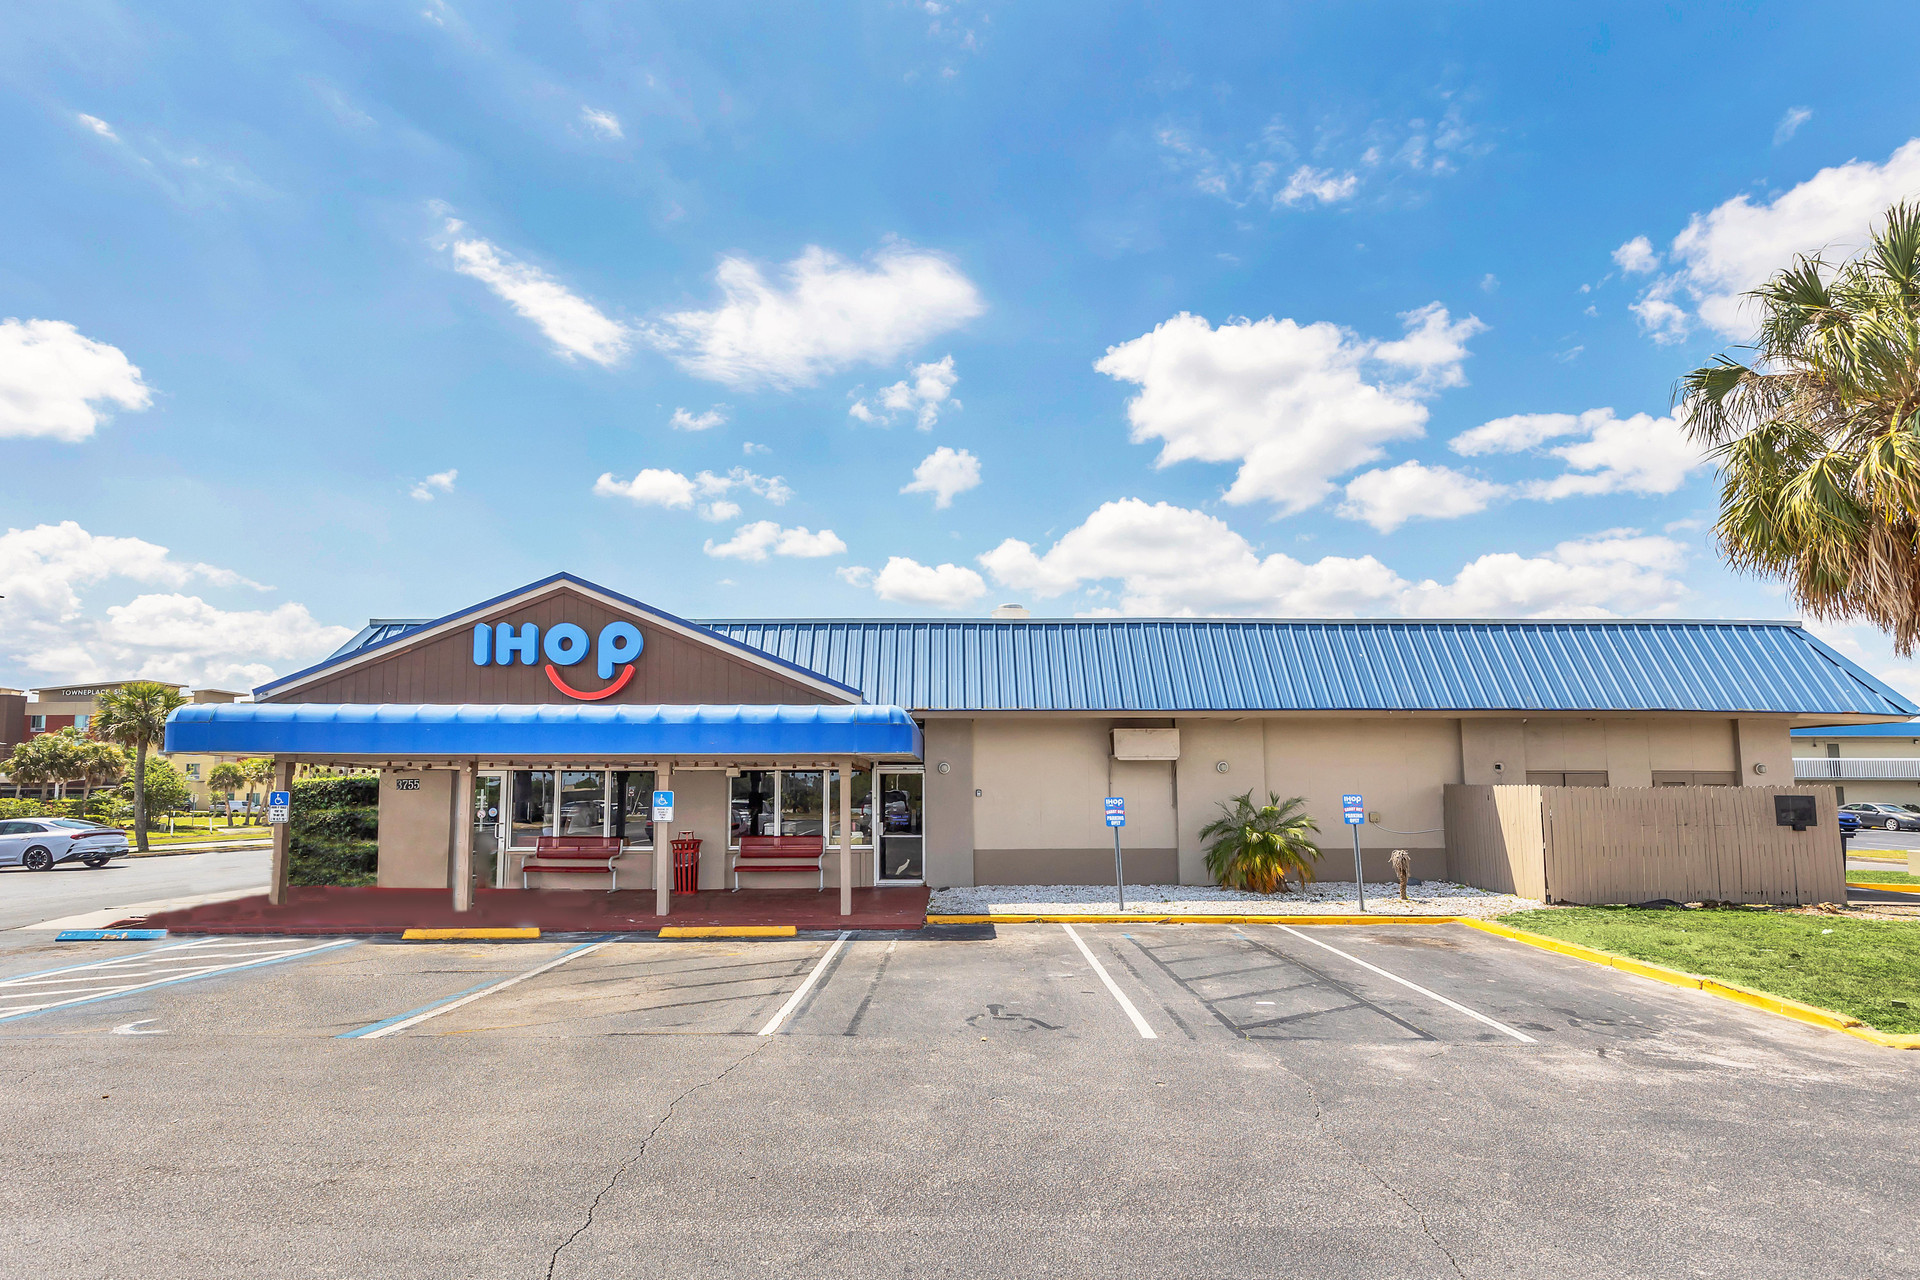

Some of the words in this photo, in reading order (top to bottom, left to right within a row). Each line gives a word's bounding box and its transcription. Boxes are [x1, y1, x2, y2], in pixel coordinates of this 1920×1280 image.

[473, 621, 644, 680] IHOP
[397, 779, 420, 790] 3755
[1344, 796, 1361, 804] IHOP
